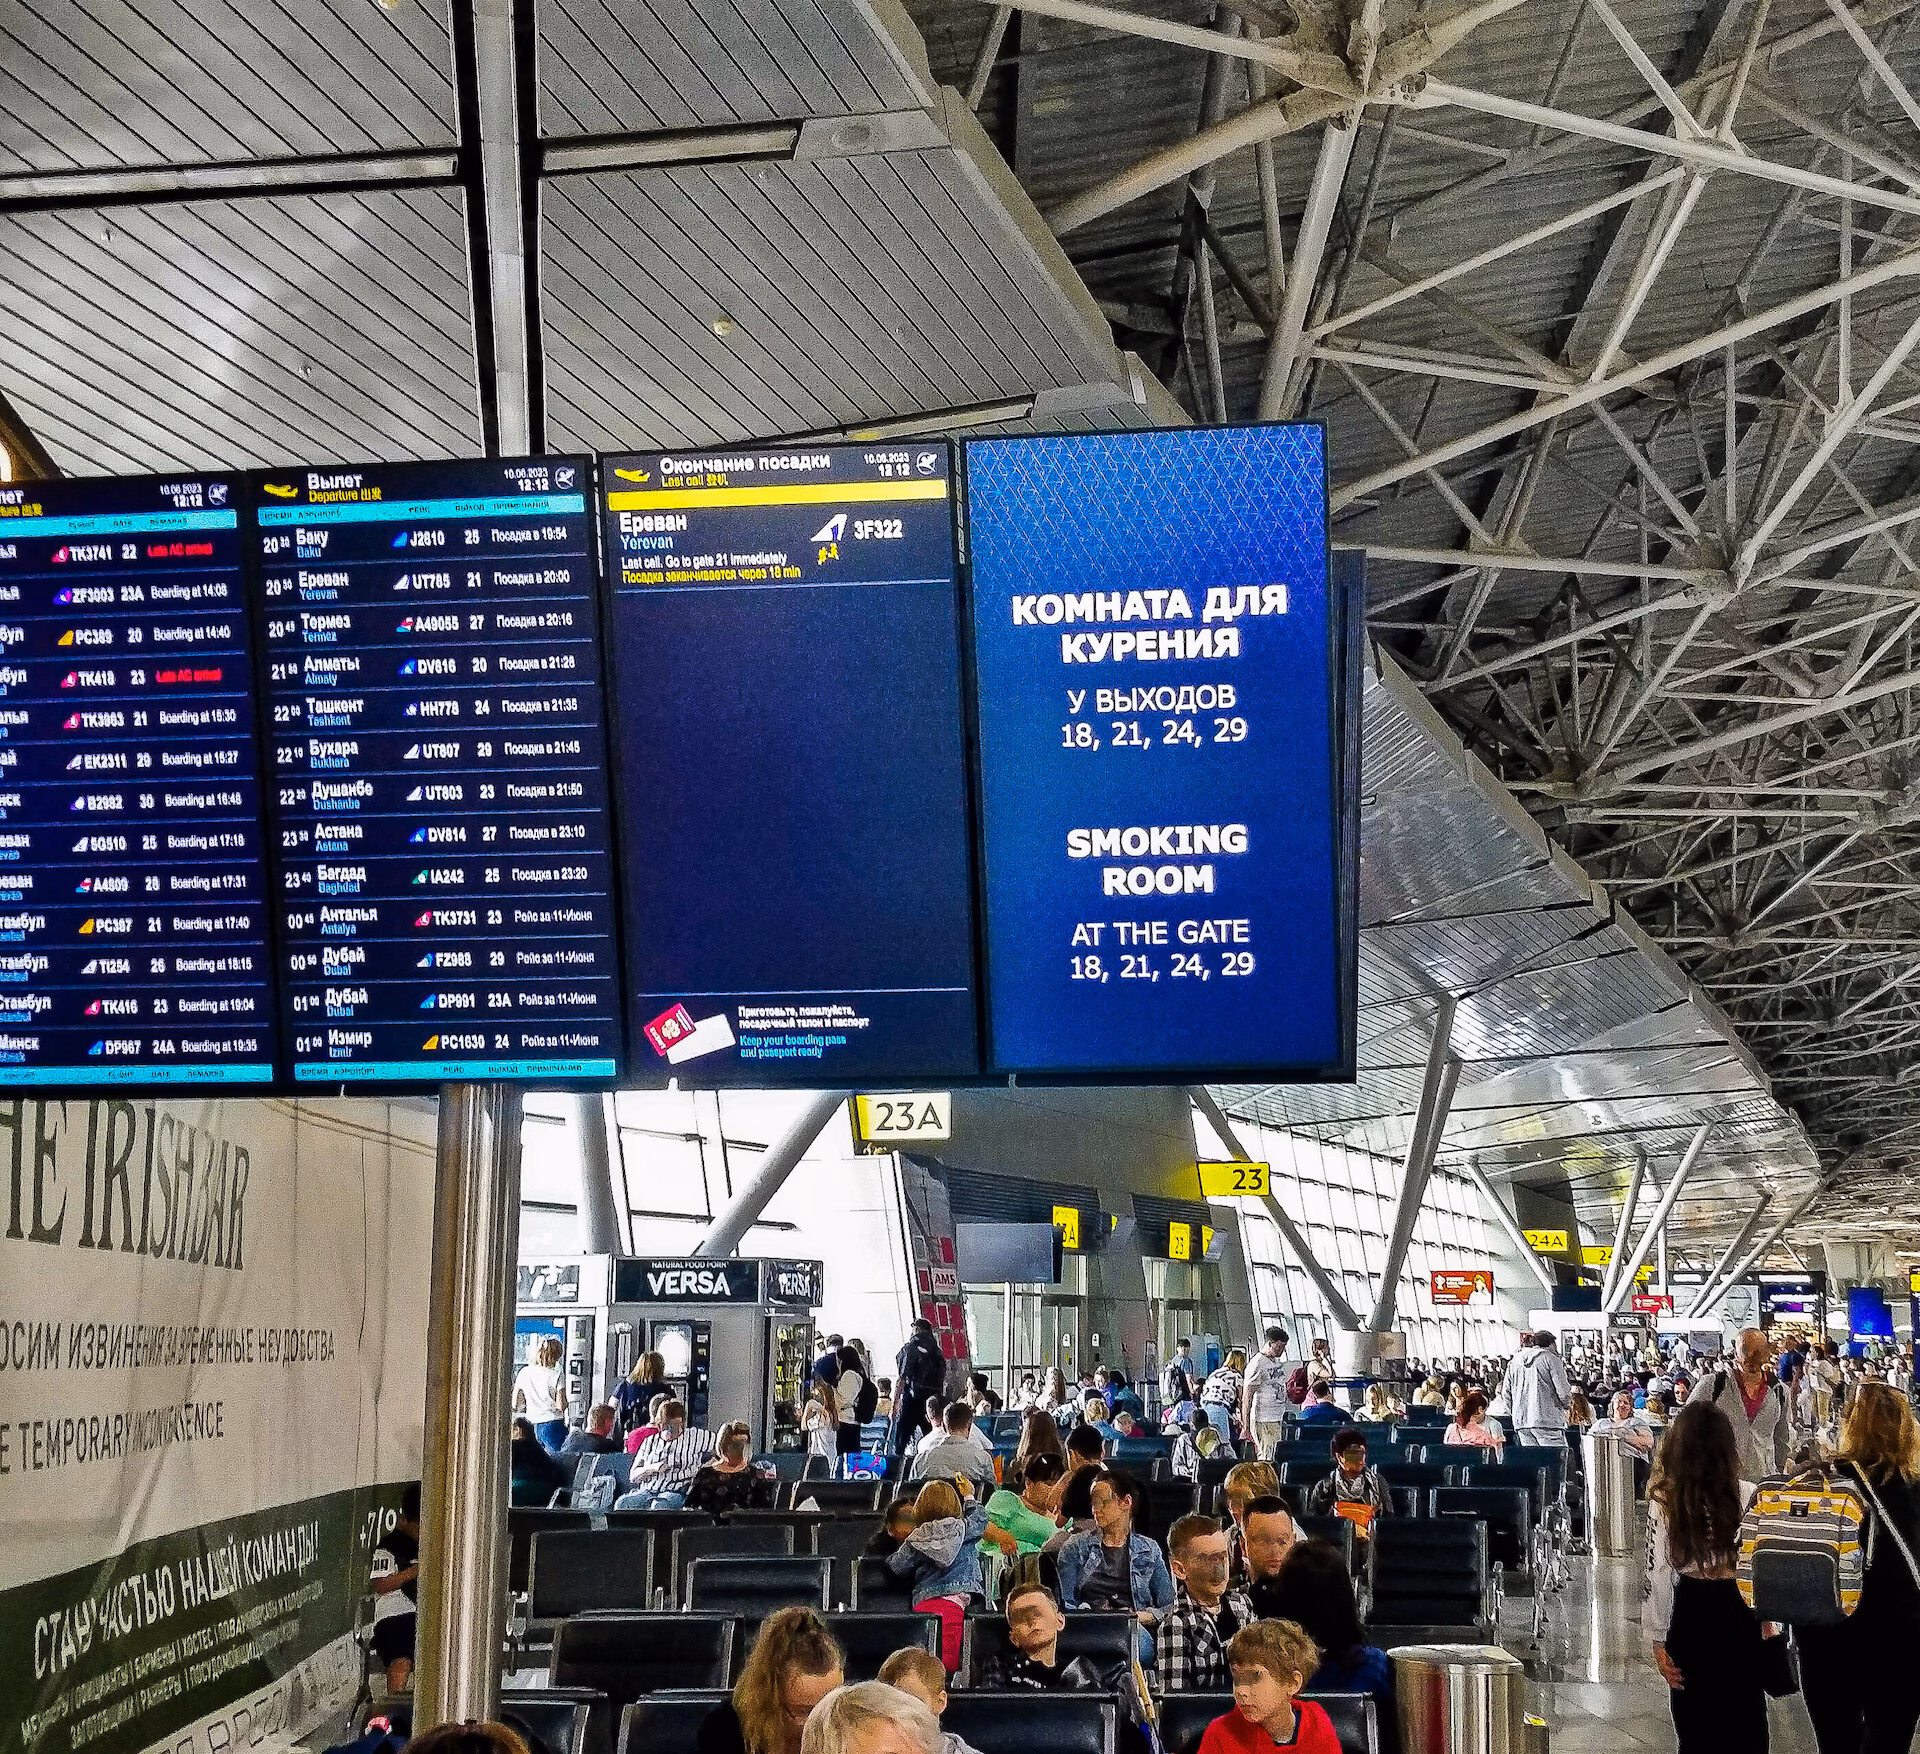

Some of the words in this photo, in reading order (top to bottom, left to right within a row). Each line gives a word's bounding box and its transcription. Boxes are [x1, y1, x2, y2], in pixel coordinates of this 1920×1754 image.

[660, 456, 755, 475] Окончание
[759, 454, 831, 473] посадки
[307, 473, 363, 491] Вылет
[517, 479, 550, 492] 12:12
[661, 475, 684, 487] Last
[686, 474, 705, 486] call
[309, 488, 358, 503] Departure
[619, 513, 687, 536] Ереван
[854, 520, 903, 540] 3F322
[296, 528, 329, 547] Баку
[491, 528, 533, 543] Посадка
[620, 535, 673, 550] Yerevan
[70, 545, 112, 561] TK3741
[122, 543, 137, 559] 22
[622, 557, 645, 569] Last
[666, 556, 679, 568] Go
[693, 554, 715, 569] gate
[716, 553, 729, 566] 21
[299, 571, 350, 590] Ереван
[467, 572, 482, 588] 21
[494, 571, 536, 586] Посадка
[623, 570, 664, 585] Посадка
[666, 568, 737, 583] заканчивается
[739, 567, 768, 582] через
[782, 565, 801, 578] min
[121, 586, 144, 602] 23A
[150, 585, 191, 600] Boarding
[300, 588, 338, 602] Yerevan
[1012, 588, 1193, 626] КОМНАТА
[1201, 585, 1289, 623] ДЛЯ
[301, 613, 351, 632] Термез
[470, 615, 485, 631] 27
[496, 614, 538, 629] Посадка
[128, 627, 142, 643] 20
[153, 627, 193, 643] Boarding
[1061, 627, 1240, 664] КУРЕНИЯ
[304, 655, 360, 672] Алматы
[472, 657, 488, 674] 20
[499, 657, 541, 671] Посадка
[130, 669, 146, 685] 23
[305, 697, 364, 714] Ташкент
[475, 699, 490, 716] 24
[501, 699, 543, 714] Посадка
[1067, 689, 1087, 714] У
[1096, 684, 1237, 715] ВЫХОДОВ
[133, 711, 148, 727] 21
[159, 711, 200, 726] Boarding
[1062, 722, 1101, 751] 18,
[1111, 721, 1152, 750] 21,
[1162, 719, 1203, 748] 24,
[1213, 717, 1248, 743] 29
[309, 738, 359, 758] Бухара
[504, 741, 546, 757] Посадка
[162, 751, 203, 767] Boarding
[311, 780, 374, 800] Душанбе
[479, 784, 495, 800] 23
[506, 783, 548, 799] Посадка
[139, 794, 155, 809] 30
[165, 793, 205, 808] Boarding
[168, 834, 208, 850] Boarding
[314, 822, 364, 839] Астана
[428, 827, 467, 843] DV814
[482, 826, 498, 842] 27
[509, 825, 550, 840] Посадка
[559, 825, 586, 839] 23:10
[1066, 824, 1249, 859] SMOKING
[171, 874, 211, 890] Boarding
[223, 873, 247, 888] 17:31
[317, 864, 367, 881] Багдад
[431, 869, 465, 885] IA242
[511, 867, 553, 883] Посадка
[561, 866, 588, 881] 23:20
[1103, 864, 1216, 896] ROOM
[148, 917, 162, 932] 21
[173, 916, 213, 932] Boarding
[225, 914, 250, 930] 17:40
[320, 905, 378, 922] Анталья
[433, 911, 477, 927] TK3731
[487, 909, 503, 925] 23
[321, 922, 357, 936] Antalya
[1071, 922, 1105, 947] AT
[1113, 920, 1169, 946] THE
[1177, 918, 1251, 945] GATE
[176, 957, 216, 973] Boarding
[322, 946, 366, 966] Дубай
[489, 950, 505, 967] 29
[1071, 955, 1110, 984] 18,
[1119, 953, 1160, 983] 21,
[1170, 953, 1211, 981] 24,
[1220, 951, 1255, 977] 29
[102, 999, 138, 1015] TK416
[154, 998, 169, 1014] 23
[178, 997, 219, 1014] Boarding
[230, 996, 255, 1011] 19:04
[325, 987, 369, 1006] Дубай
[487, 991, 513, 1008] 23A
[738, 1006, 798, 1019] Приготовьте,
[799, 1005, 855, 1018] пожалуйста,
[739, 1016, 796, 1030] посадочный
[797, 1017, 824, 1028] талон
[832, 1016, 869, 1029] паспорт
[105, 1039, 142, 1055] DP967
[153, 1039, 176, 1055] 24A
[181, 1038, 222, 1055] Boarding
[233, 1037, 258, 1052] 19:35
[328, 1029, 373, 1048] Измир
[441, 1034, 486, 1050] PC1630
[494, 1033, 510, 1049] 24
[740, 1035, 763, 1047] Keep
[763, 1037, 784, 1048] your
[785, 1034, 824, 1047] boarding
[825, 1035, 847, 1047] pass
[740, 1046, 757, 1058] and
[758, 1047, 798, 1060] passport
[798, 1046, 823, 1060] ready
[874, 1101, 944, 1132] 23A
[1232, 1168, 1263, 1191] 23
[1529, 1234, 1565, 1249] 24A
[647, 1271, 732, 1296] VERSA
[934, 1273, 956, 1286] AMS
[258, 1327, 336, 1368] НЕУДОБСТВА
[18, 1411, 133, 1471] TEMPORARY
[99, 1563, 175, 1642] ЧАСТЬЮ
[179, 1534, 244, 1610] НАШЕЙ
[243, 1520, 320, 1586] КОМАНДЫ!
